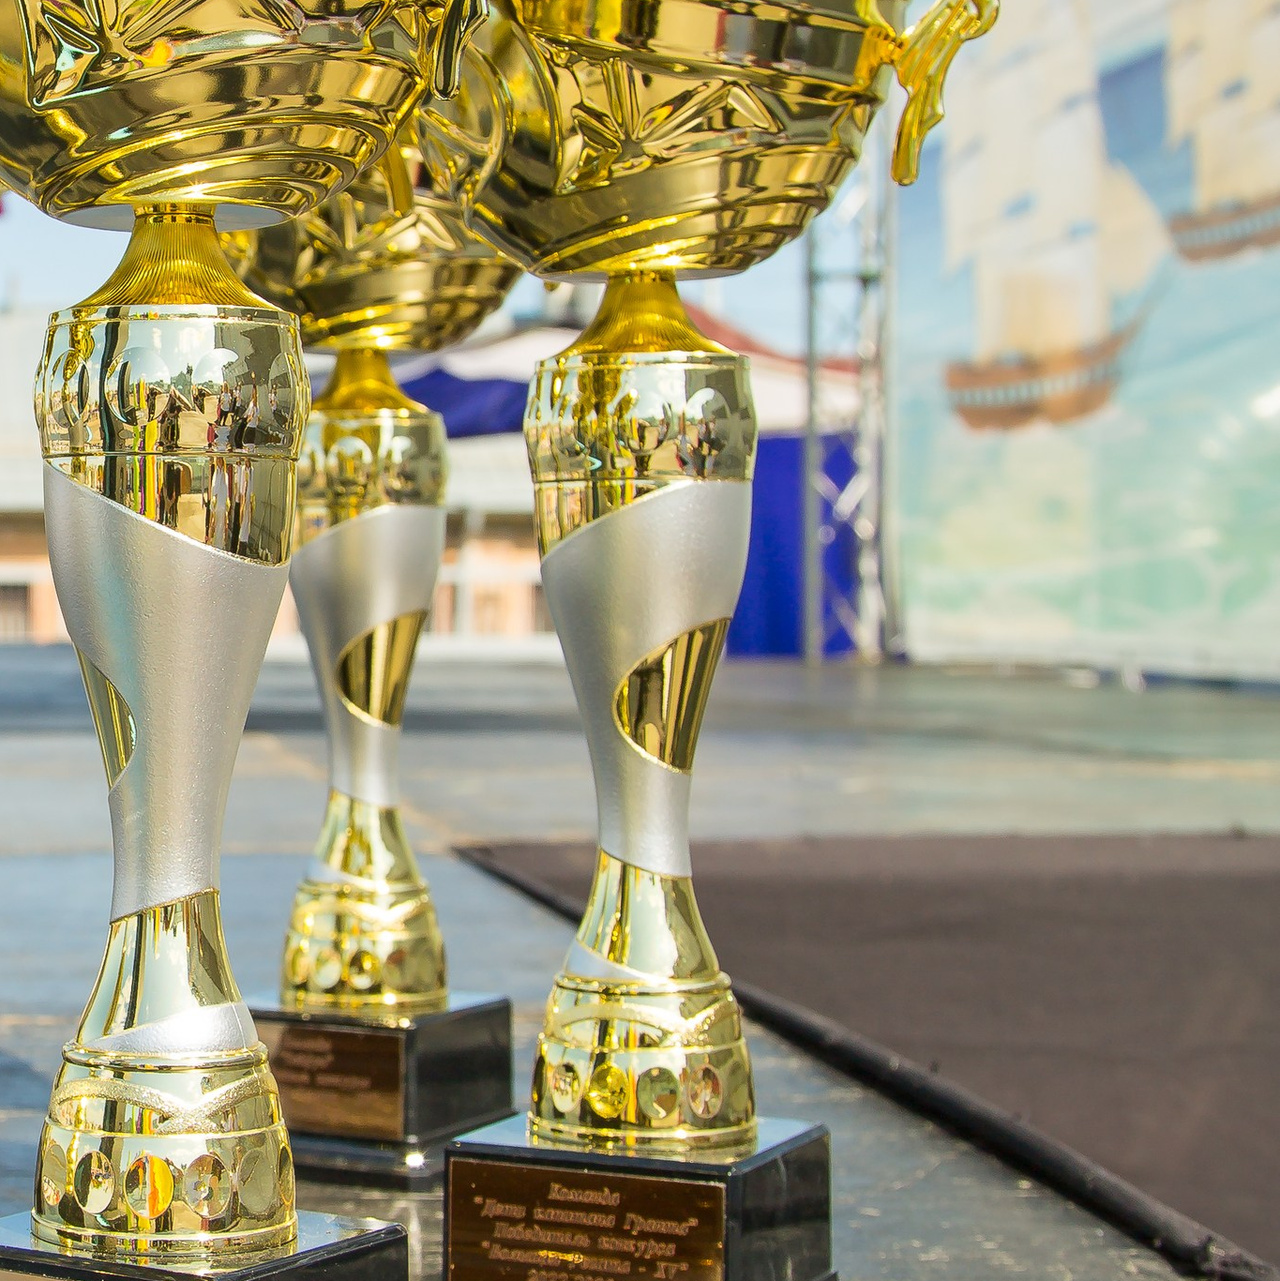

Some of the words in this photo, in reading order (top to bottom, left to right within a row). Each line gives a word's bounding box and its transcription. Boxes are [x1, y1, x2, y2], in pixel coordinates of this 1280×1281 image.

[548, 1182, 620, 1206] Команда
[533, 1207, 615, 1228] капитана
[494, 1222, 590, 1248] Победитель
[598, 1235, 676, 1258] конкурса
